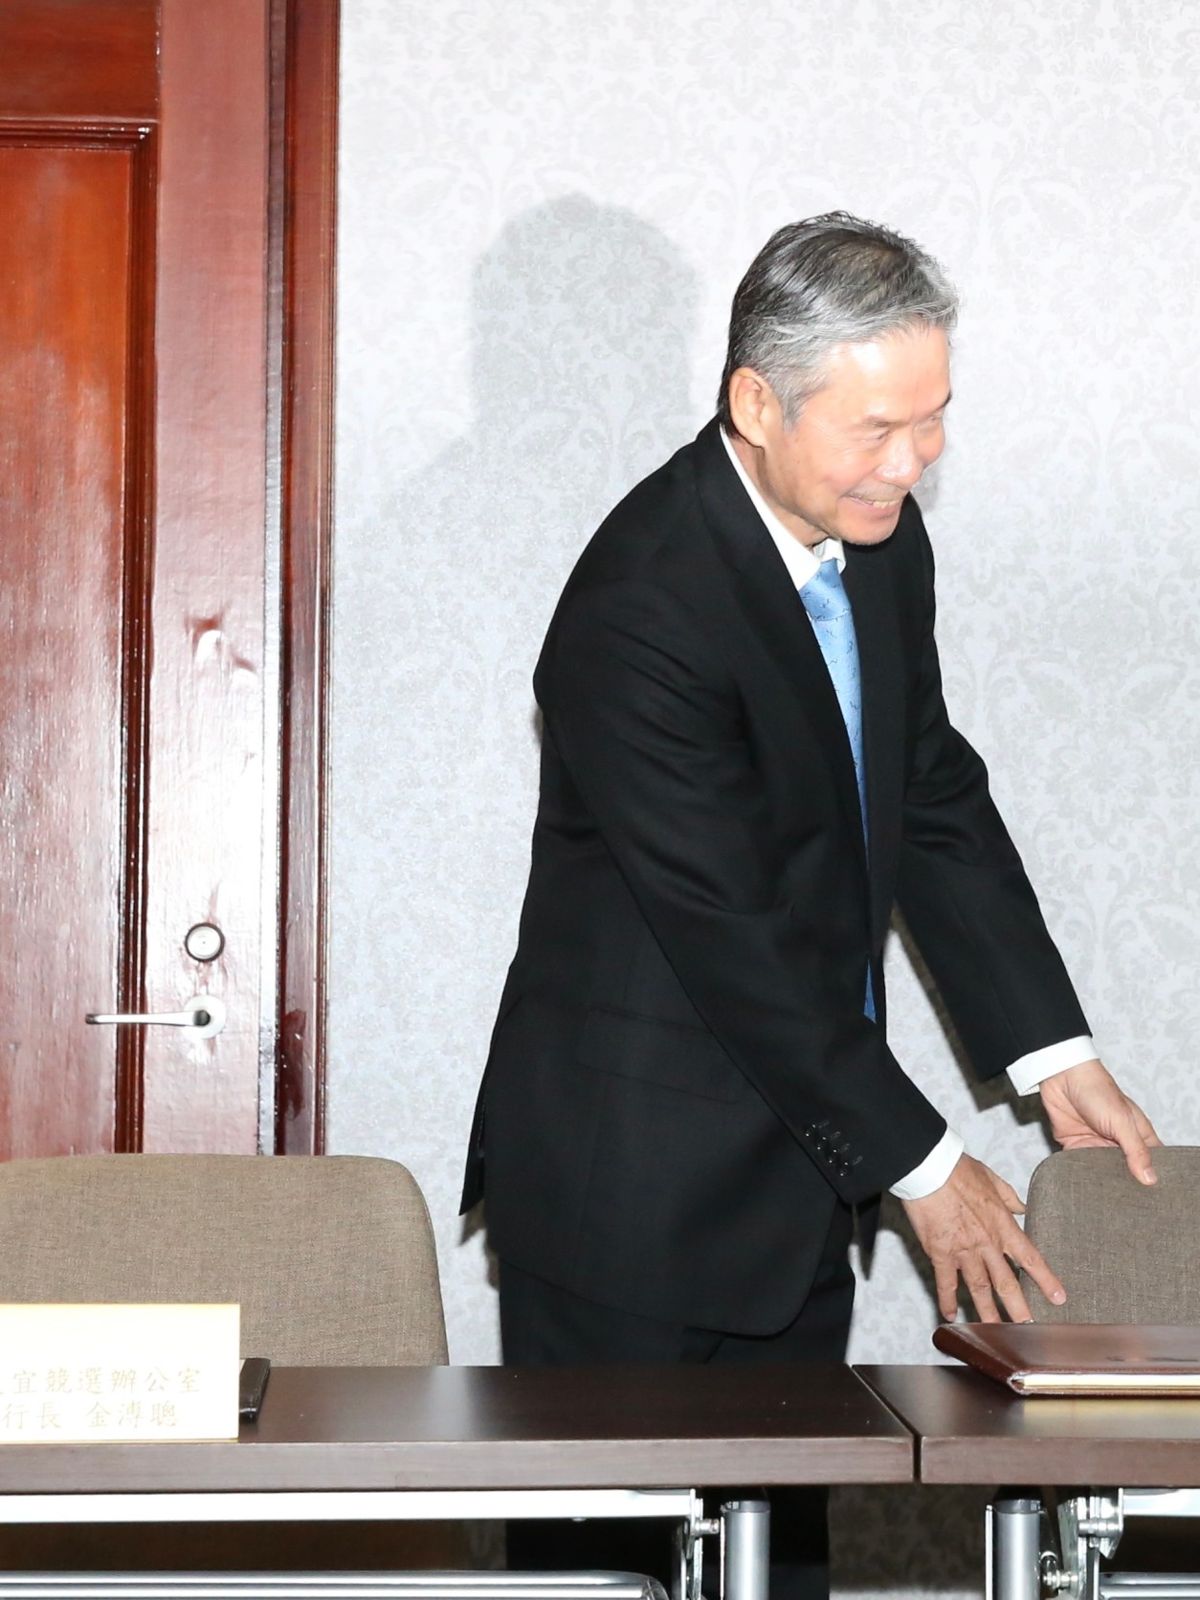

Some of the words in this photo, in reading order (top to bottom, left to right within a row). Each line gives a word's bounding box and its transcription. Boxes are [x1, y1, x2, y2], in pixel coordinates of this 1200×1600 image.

[0, 1366, 201, 1396] 宜競選辦公室
